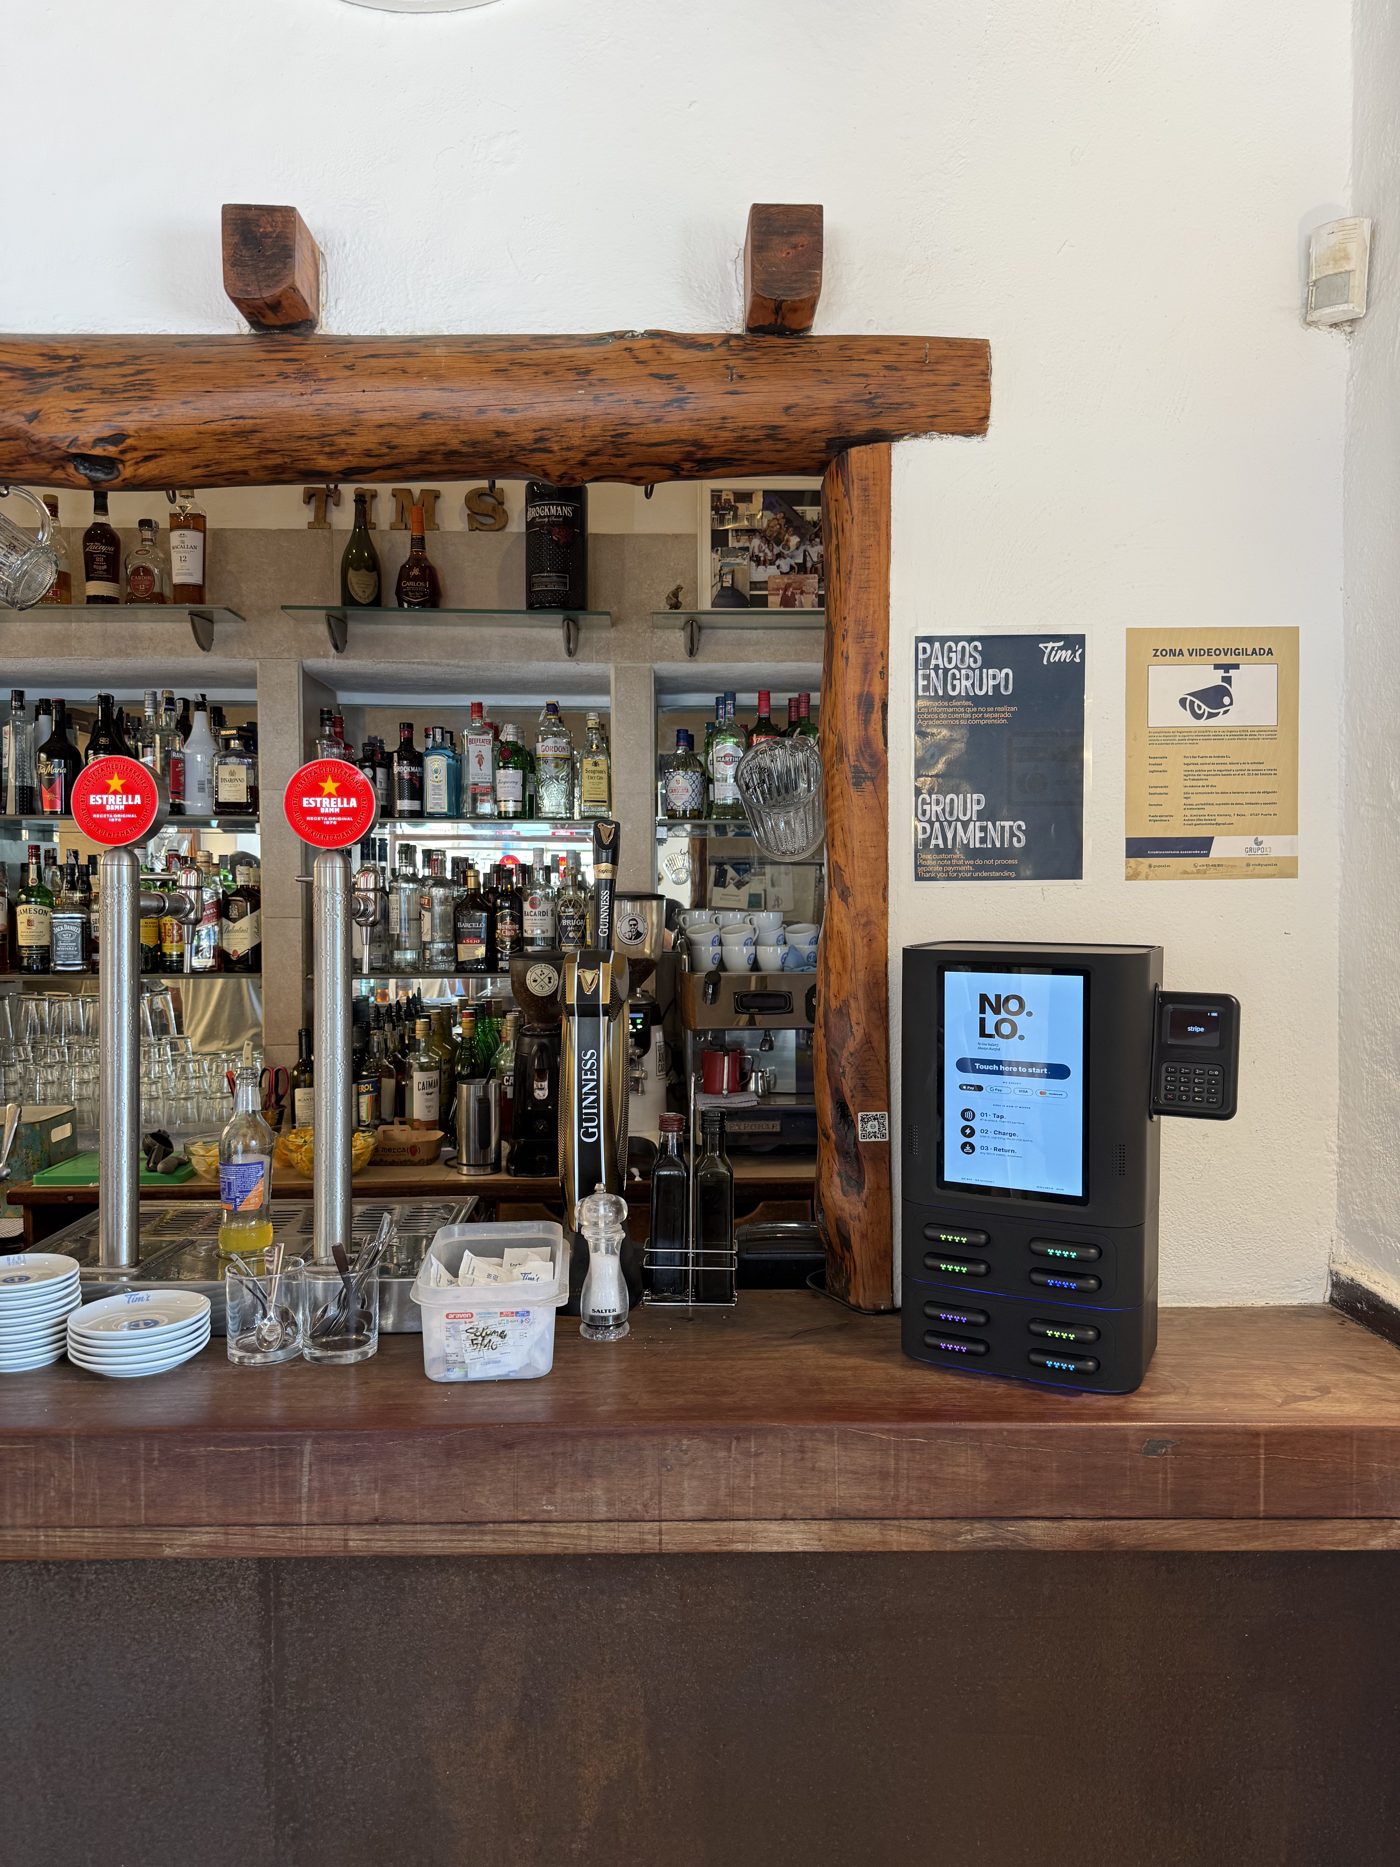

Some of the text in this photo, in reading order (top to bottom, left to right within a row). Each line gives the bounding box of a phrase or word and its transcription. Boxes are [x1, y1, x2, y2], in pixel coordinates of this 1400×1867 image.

[527, 505, 573, 521] BROCKMANS
[918, 641, 983, 669] PAGOS
[1039, 640, 1083, 665] Tim's
[1152, 647, 1274, 658] ZONA VIDEOVIGILADA
[918, 668, 1014, 696] EN GRUPO
[984, 711, 1012, 719] separado.
[468, 738, 492, 746] BEEFEATER
[89, 794, 142, 805] ESTRELLA
[302, 797, 358, 808] ESTRELLA
[918, 794, 985, 821] GROUP
[918, 821, 1027, 849] PAYMENTS
[972, 870, 1017, 878] understanding.
[599, 890, 610, 937] GUINNESS
[978, 993, 1033, 1018] NO.
[978, 1017, 1025, 1041] LO.
[974, 1063, 999, 1071] Touch
[999, 1063, 1018, 1072] here
[1018, 1065, 1027, 1073] to
[580, 1049, 598, 1143] GUINNESS
[993, 1130, 1019, 1138] Charge.
[993, 1146, 1017, 1154] Return.
[447, 1312, 472, 1320] araven
[591, 1307, 618, 1315] SALTER
